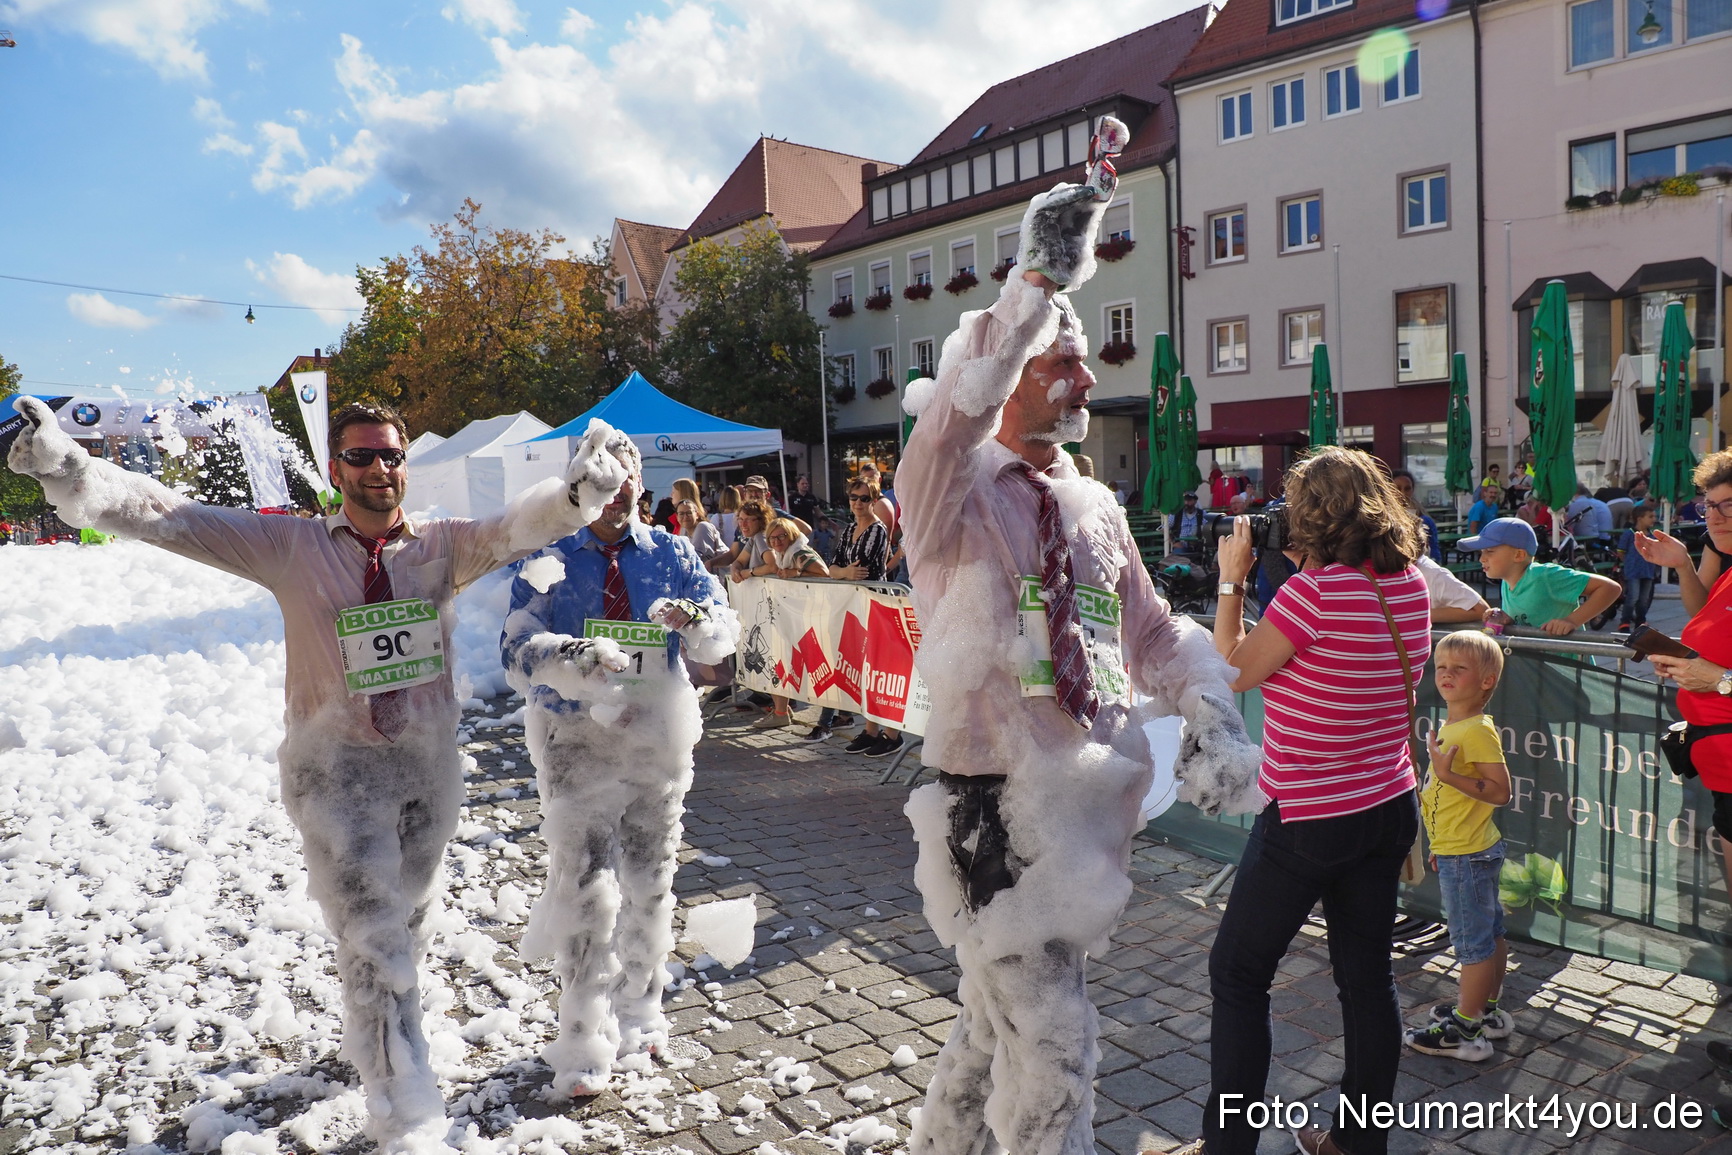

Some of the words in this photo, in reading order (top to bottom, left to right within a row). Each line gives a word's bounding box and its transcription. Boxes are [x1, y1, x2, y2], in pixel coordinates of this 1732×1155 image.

[679, 442, 707, 451] classic
[345, 603, 424, 630] BOCK
[372, 630, 415, 661] 90
[593, 625, 660, 643] BOCK
[359, 660, 435, 685] MATTHIAS
[808, 661, 830, 685] Braun
[862, 661, 906, 699] Braun
